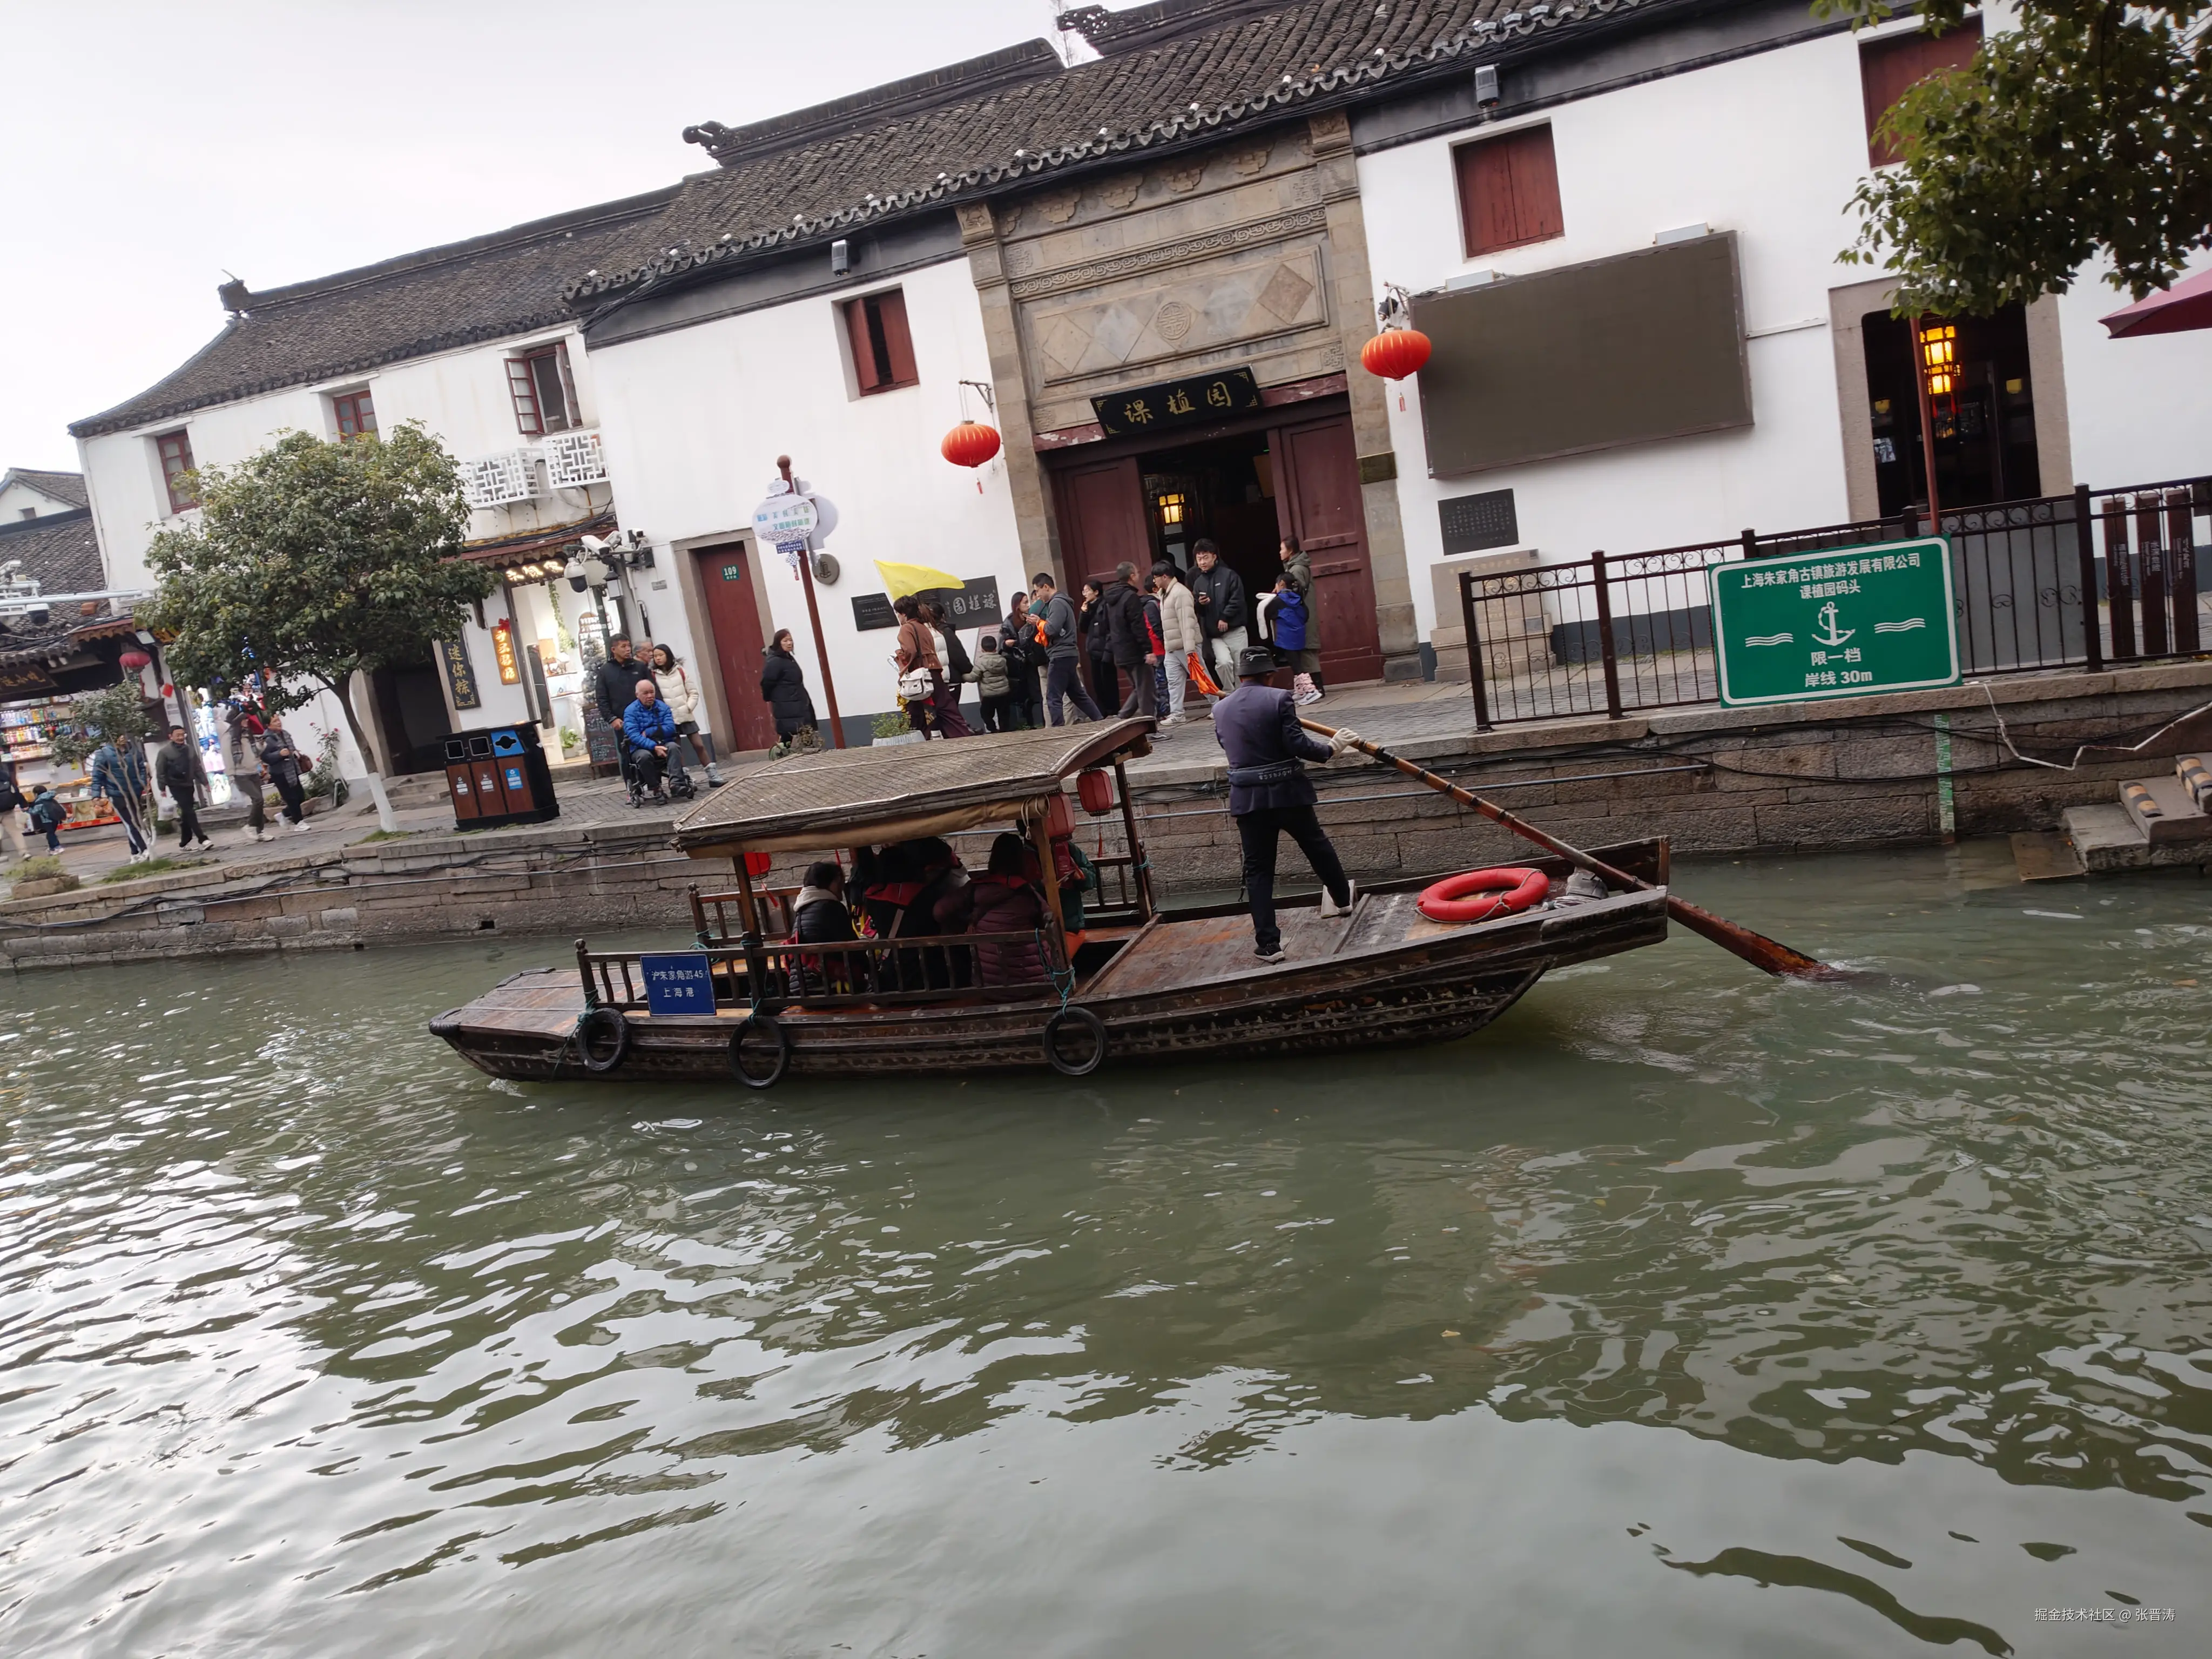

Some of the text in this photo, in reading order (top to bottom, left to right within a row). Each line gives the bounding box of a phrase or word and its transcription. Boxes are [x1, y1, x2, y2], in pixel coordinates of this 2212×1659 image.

[1124, 381, 1232, 424] 课植园
[724, 566, 737, 576] 109
[1741, 552, 1920, 589] 上海朱家角古镇旅游发展有限公司
[1799, 579, 1861, 599] 课植园码头
[444, 638, 471, 694] 迷你粽
[1811, 647, 1862, 666] 限一档
[1805, 670, 1872, 687] 岸线 30m
[663, 987, 694, 997] 上海港
